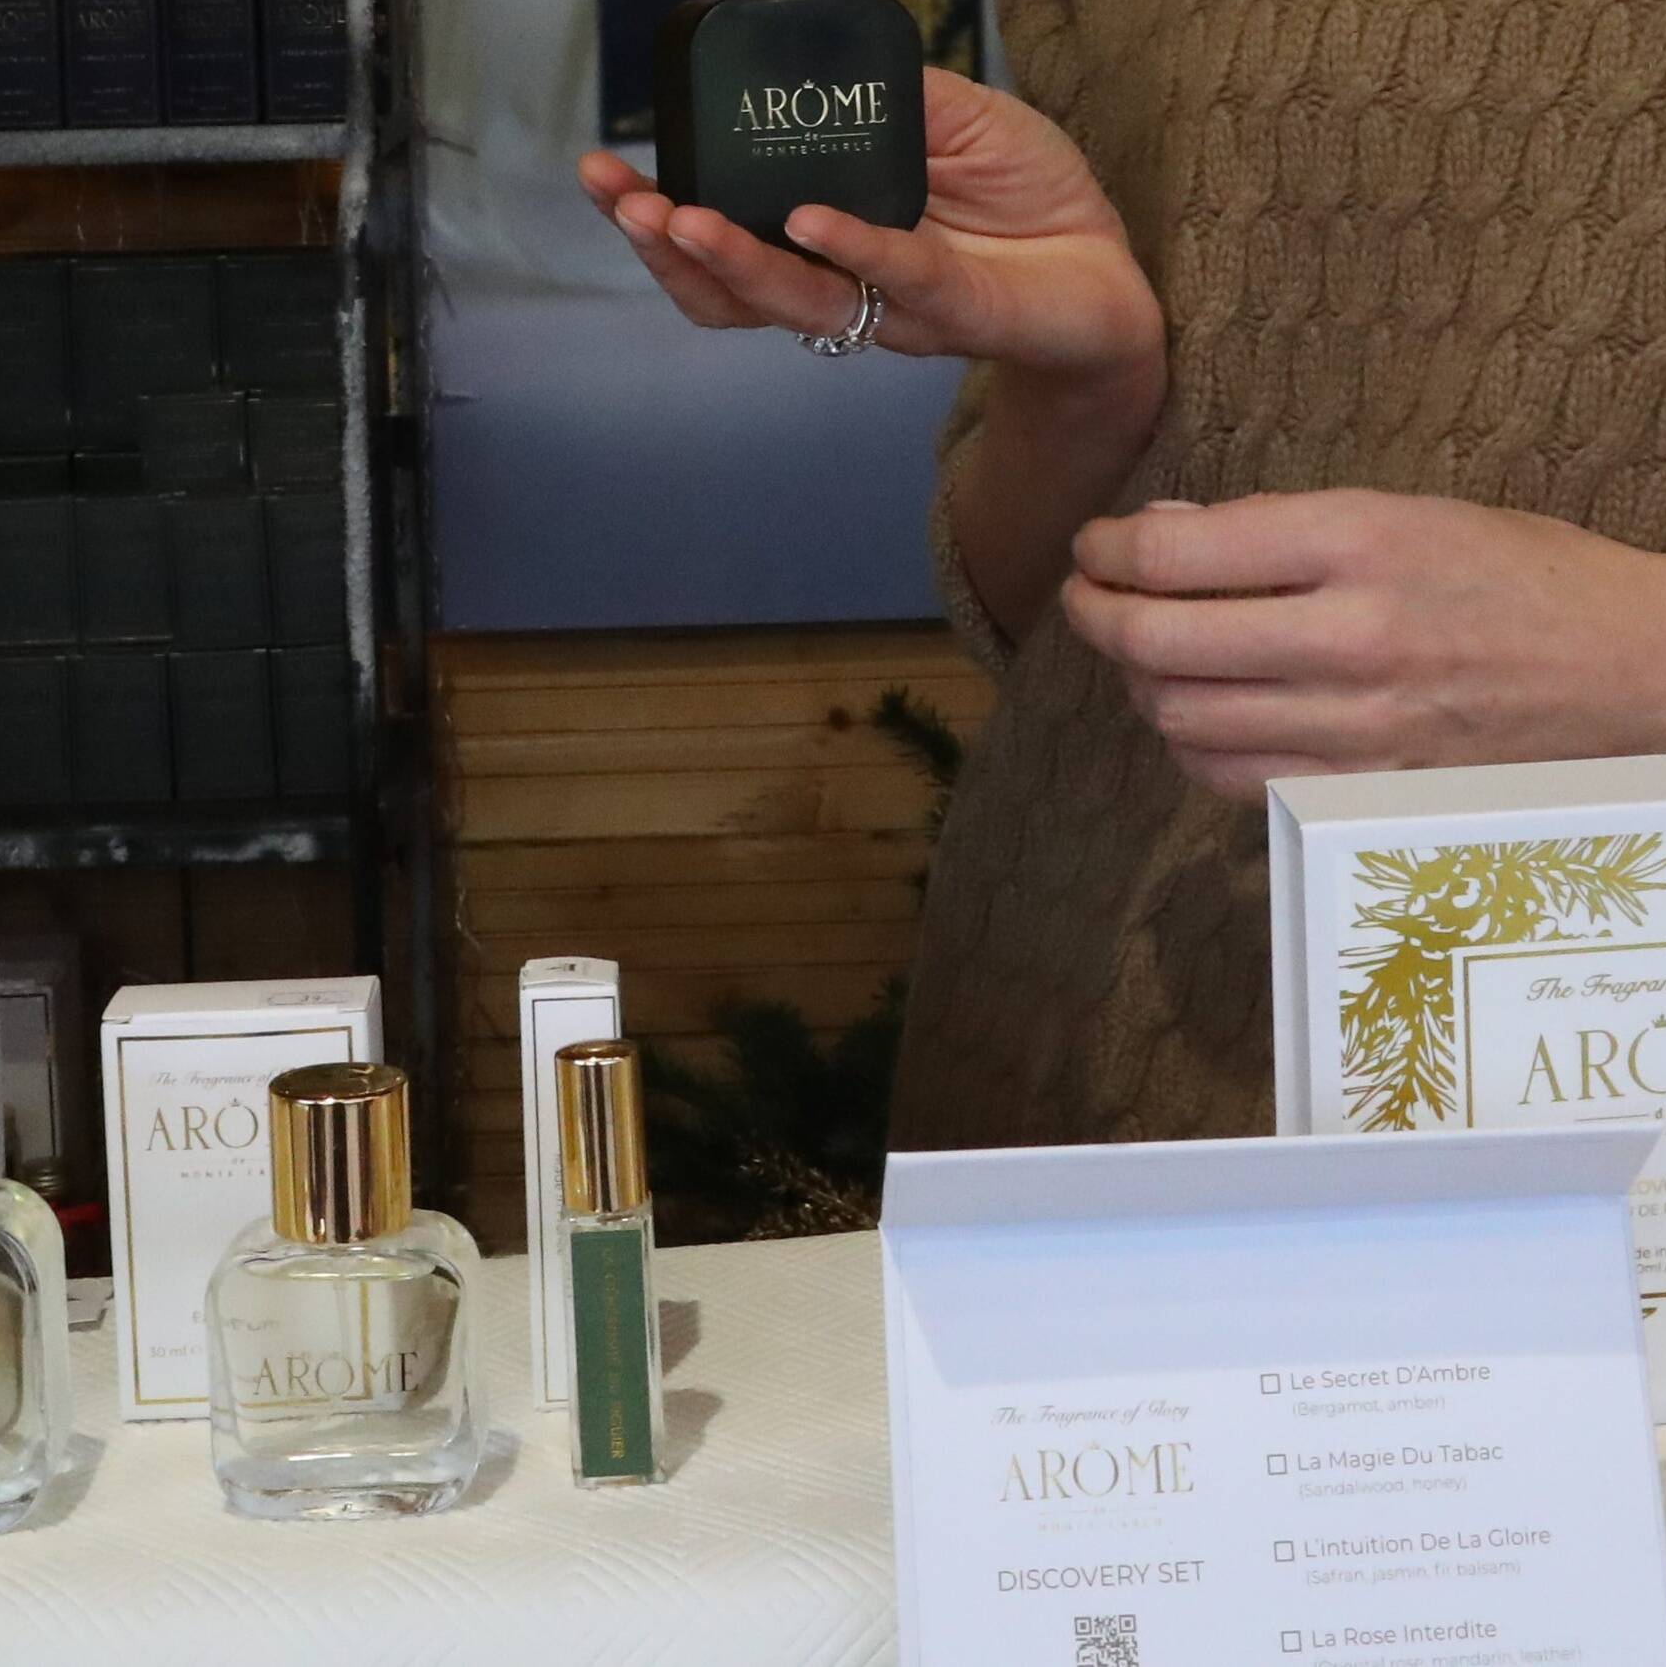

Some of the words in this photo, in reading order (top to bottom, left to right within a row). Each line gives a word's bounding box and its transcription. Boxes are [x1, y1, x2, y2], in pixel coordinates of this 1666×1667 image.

[1527, 978, 1572, 1001] The
[149, 1071, 176, 1085] The
[188, 1070, 252, 1090] Fragrance
[146, 1097, 259, 1151] ARO
[1638, 1205, 1658, 1217] DE
[1636, 1247, 1651, 1259] de
[1637, 1262, 1661, 1274] 0ml
[1291, 1373, 1315, 1390] Le
[1321, 1369, 1389, 1389] Secret
[1397, 1363, 1490, 1384] D'Ambre
[991, 1407, 1026, 1425] The
[1033, 1404, 1118, 1427] Fragrance
[1122, 1400, 1141, 1425] of
[1148, 1398, 1190, 1421] Glory
[1298, 1453, 1321, 1471] La
[1329, 1450, 1395, 1472] Magie
[1402, 1447, 1432, 1465] Du
[1438, 1443, 1503, 1462] Tabac
[1421, 1533, 1450, 1552] De
[1457, 1531, 1481, 1549] La
[1488, 1527, 1551, 1547] Gloire
[998, 1563, 1150, 1592] DISCOVERY
[1158, 1560, 1205, 1583] SET
[1312, 1631, 1335, 1648] La
[1344, 1628, 1396, 1647] Rose
[1404, 1621, 1497, 1643] Interdite
